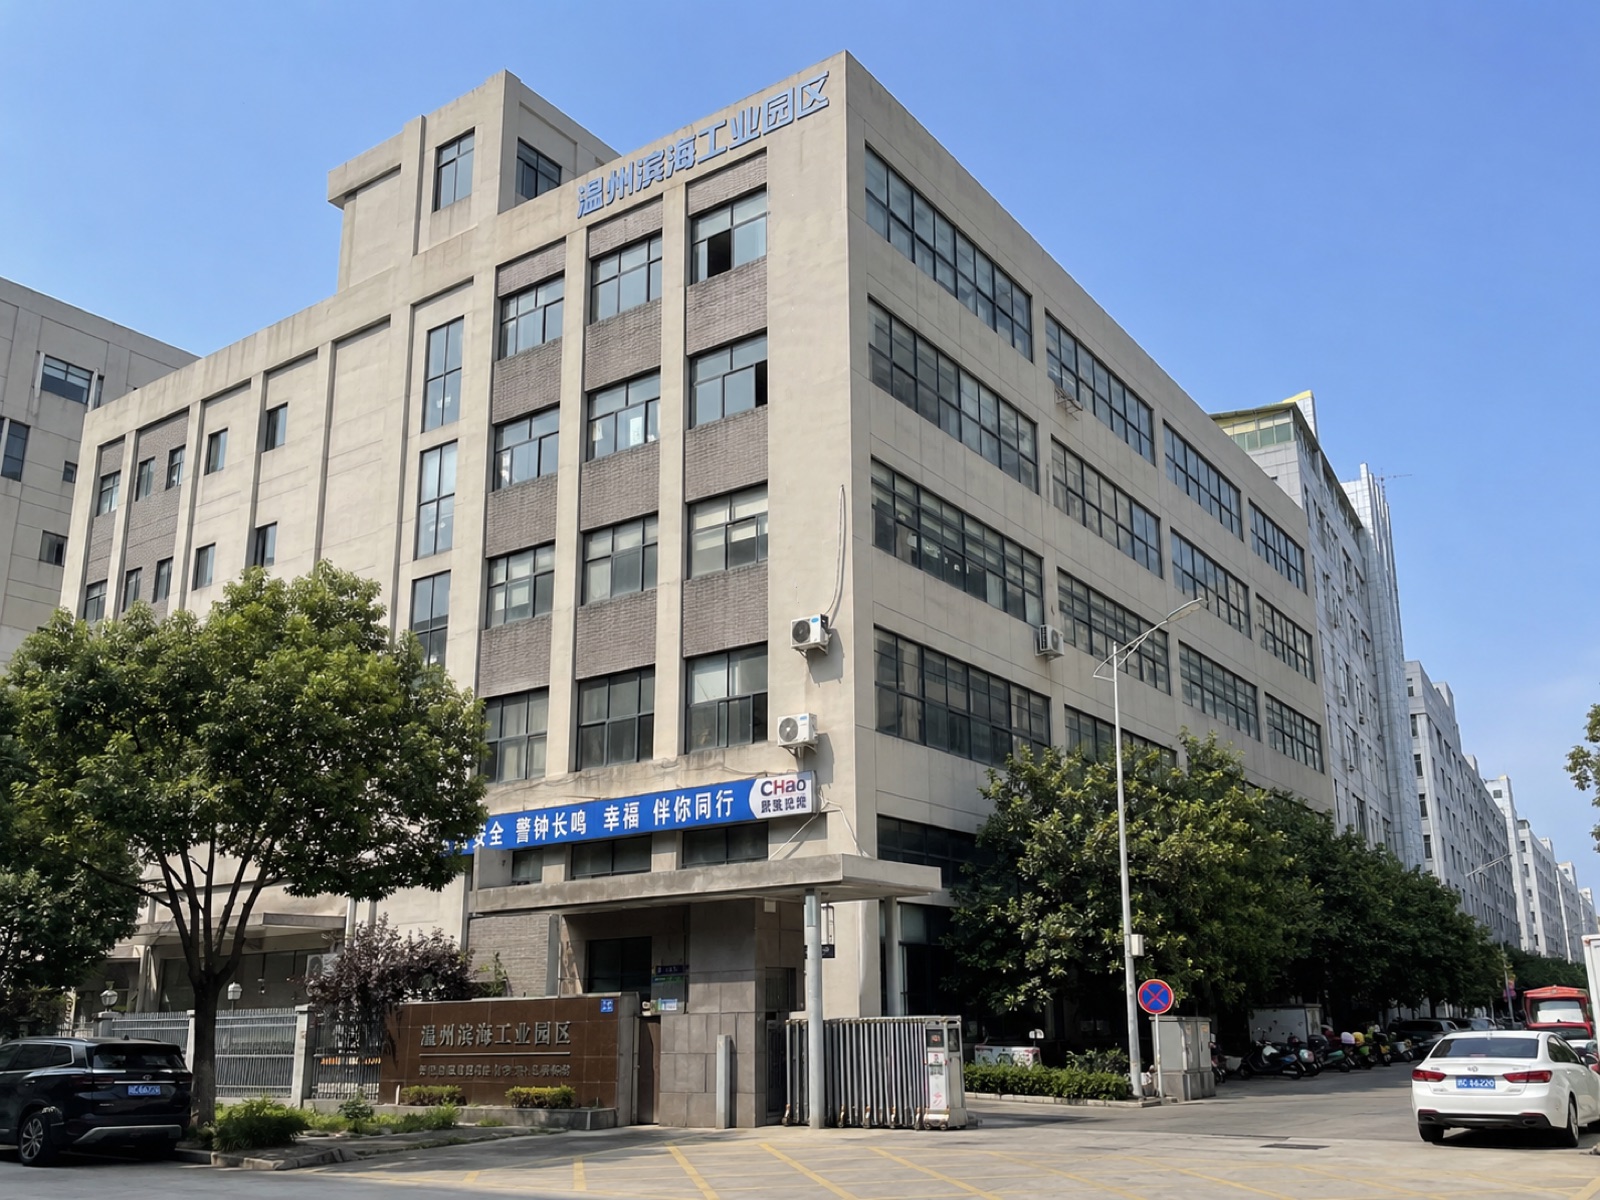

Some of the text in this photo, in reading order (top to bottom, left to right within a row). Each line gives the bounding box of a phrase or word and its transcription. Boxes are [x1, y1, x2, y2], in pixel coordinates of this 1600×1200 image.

[577, 71, 829, 219] 温州滨海工业园区
[516, 809, 586, 844] 警钟长鸣
[603, 801, 640, 832] 幸福
[652, 789, 734, 826] 伴你同行
[420, 1021, 571, 1047] 温州滨海工业园区
